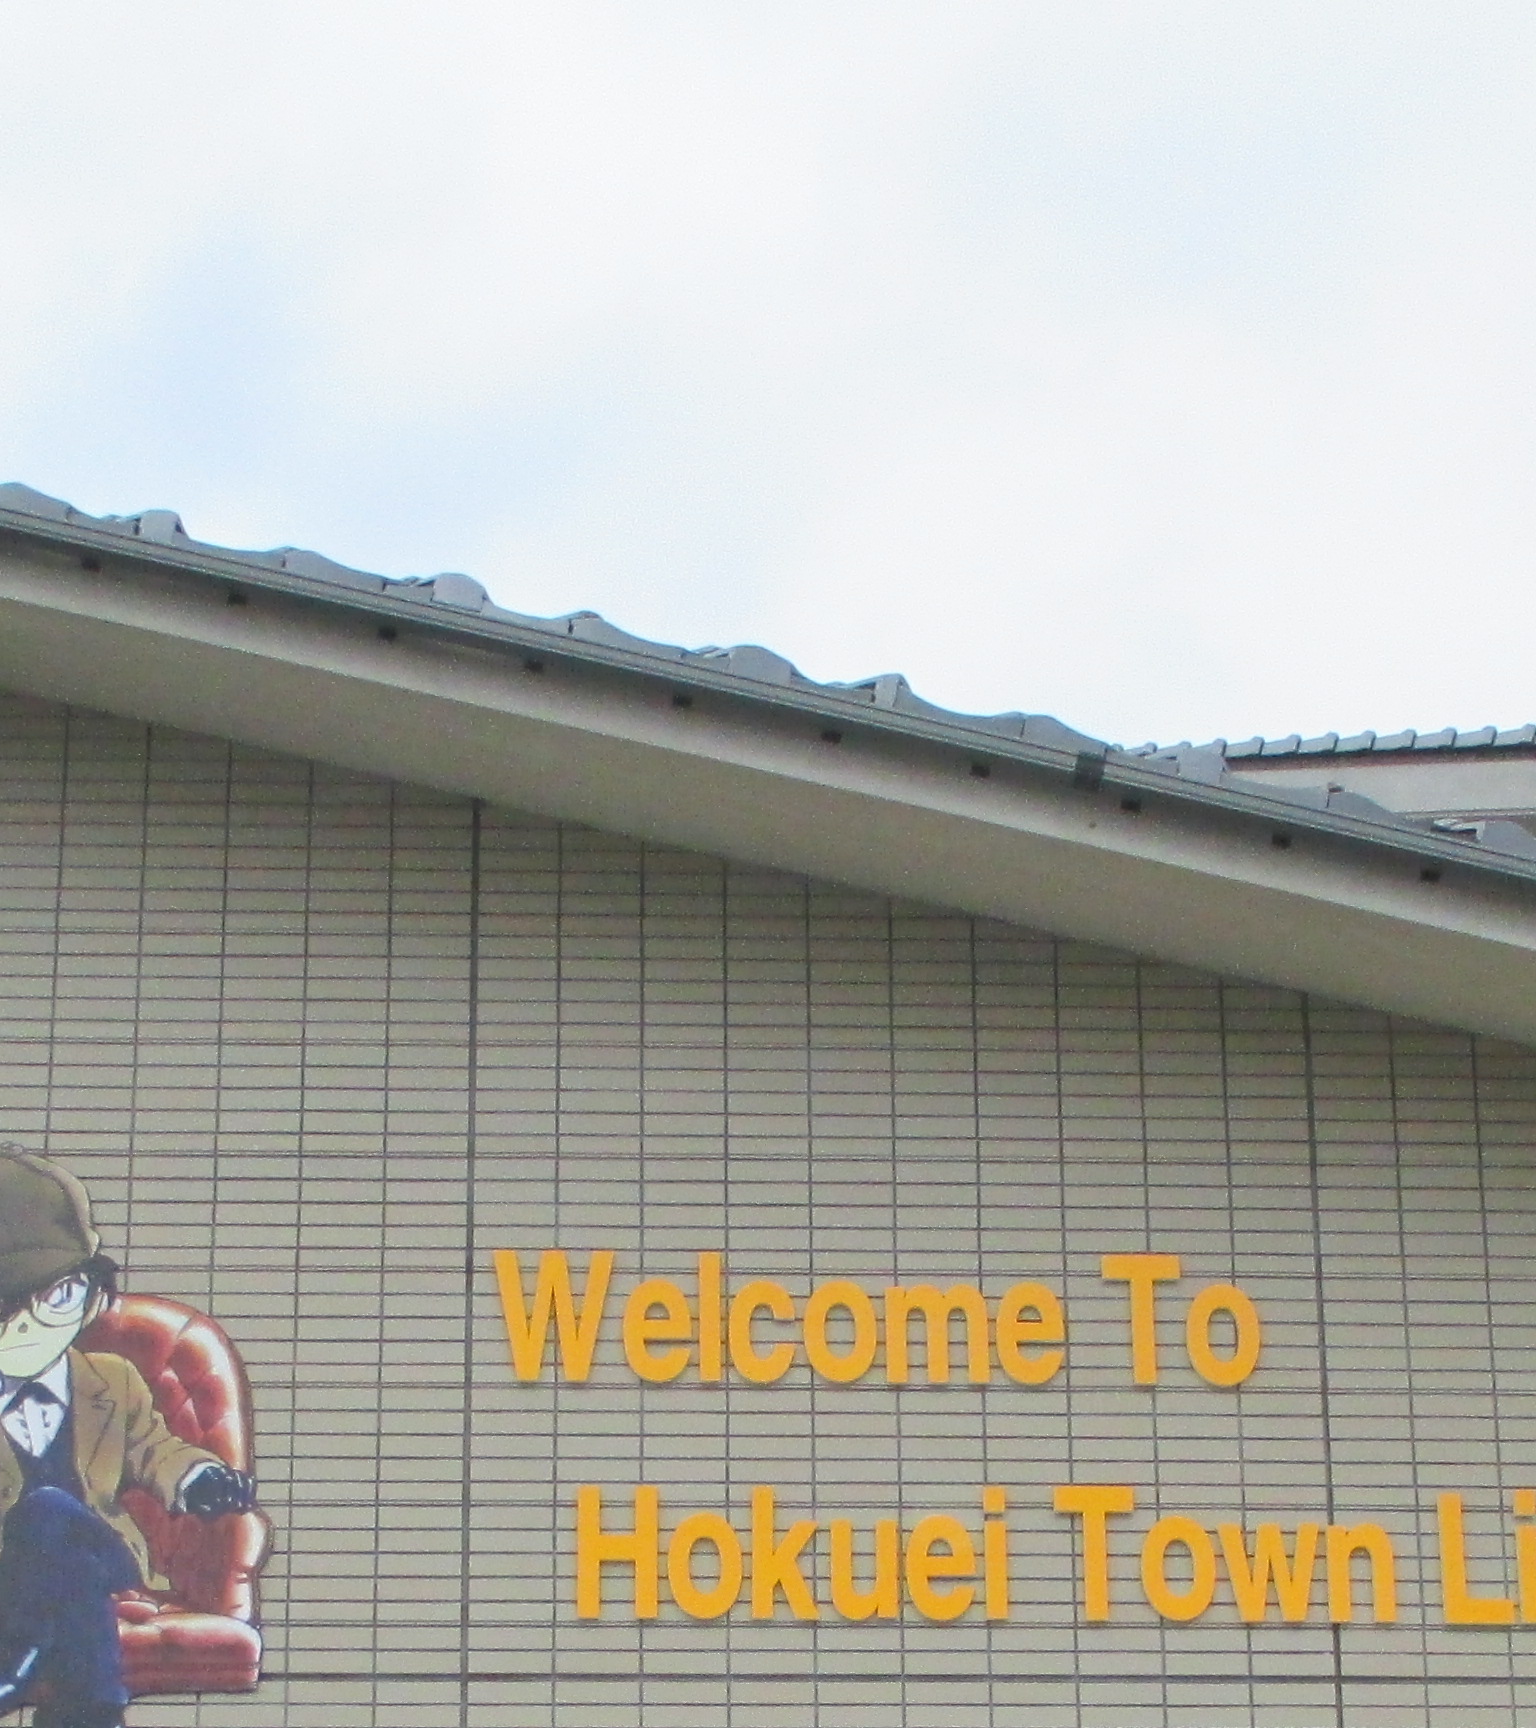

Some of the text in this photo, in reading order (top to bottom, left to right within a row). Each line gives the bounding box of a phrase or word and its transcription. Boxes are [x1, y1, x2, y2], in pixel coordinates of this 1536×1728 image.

[495, 1250, 1262, 1387] Welcome To
[576, 1485, 1010, 1621] Hokuei
[1053, 1484, 1398, 1624] Town
